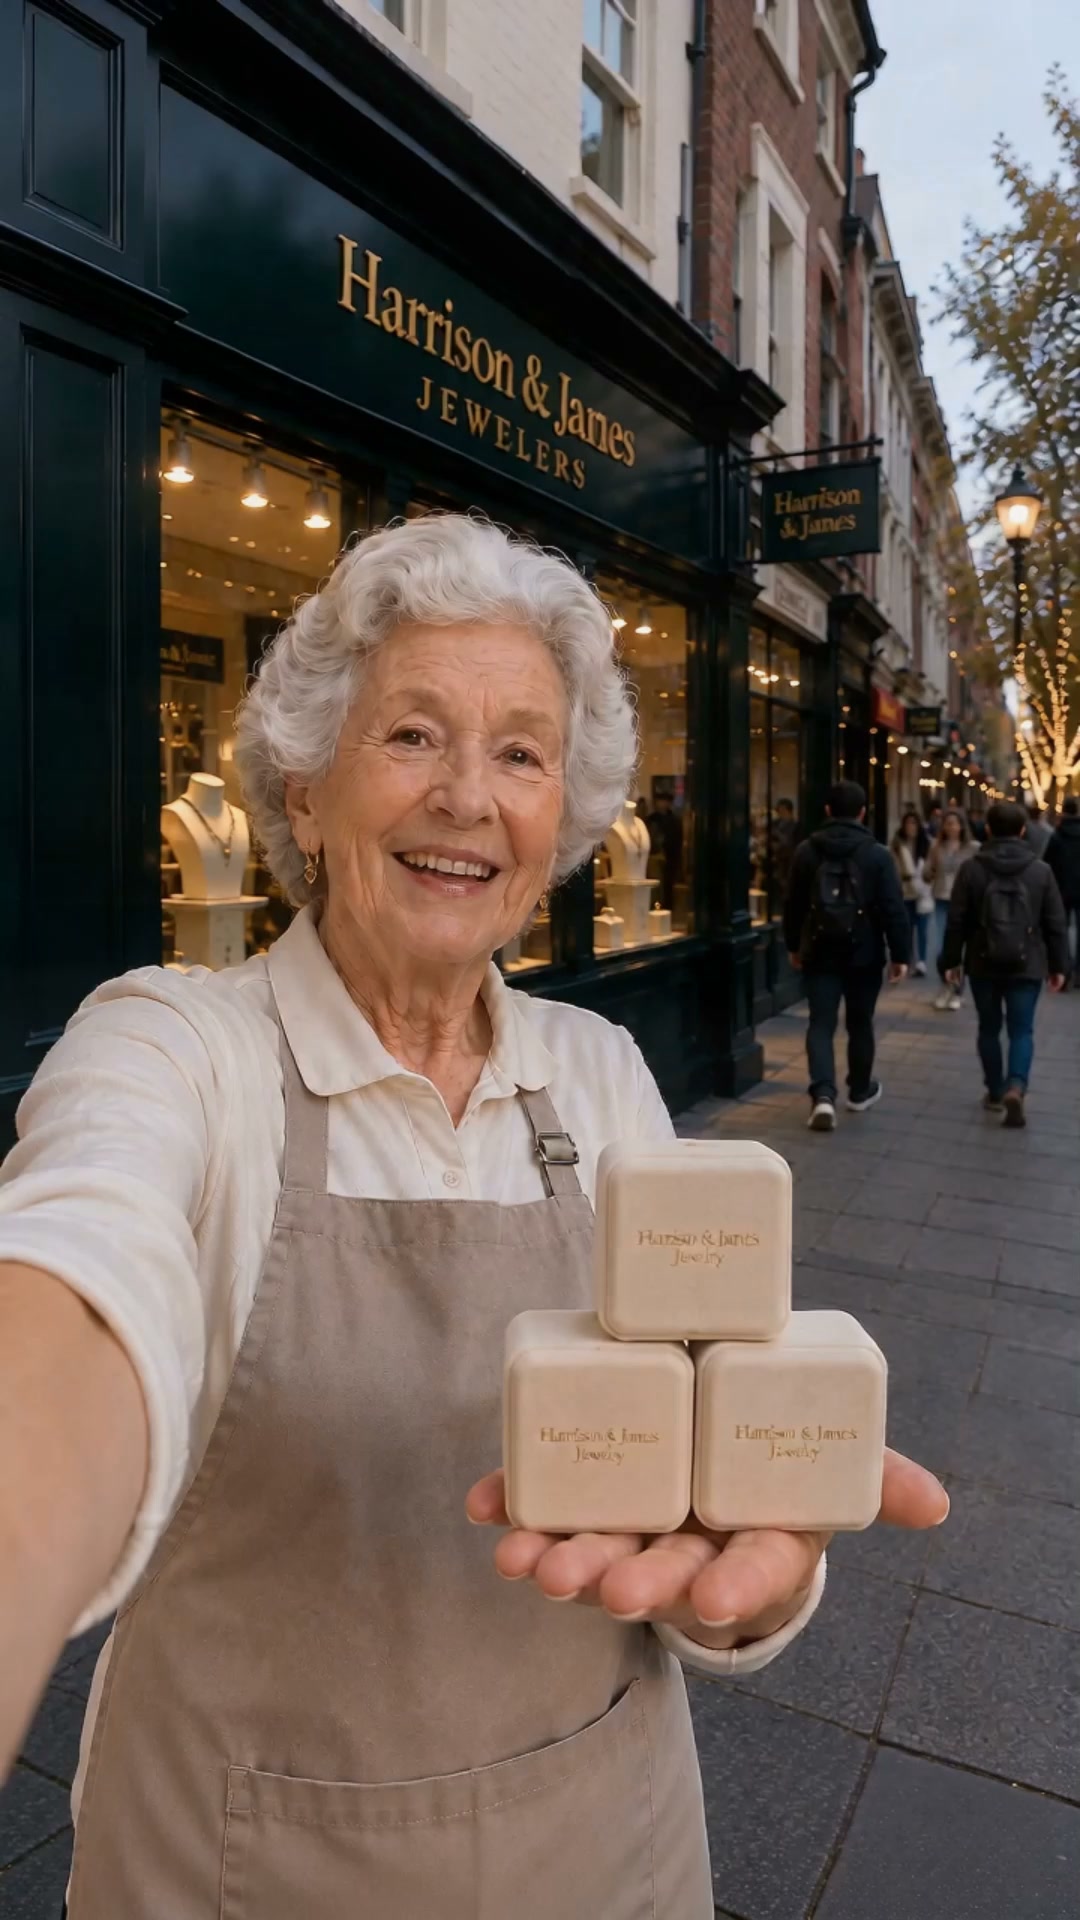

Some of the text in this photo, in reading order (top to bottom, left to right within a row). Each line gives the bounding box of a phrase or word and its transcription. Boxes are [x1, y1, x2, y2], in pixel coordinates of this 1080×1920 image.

[337, 233, 516, 399] Harrison
[522, 354, 551, 418] &
[416, 376, 586, 489] JEWELERS
[774, 487, 861, 515] Harrison
